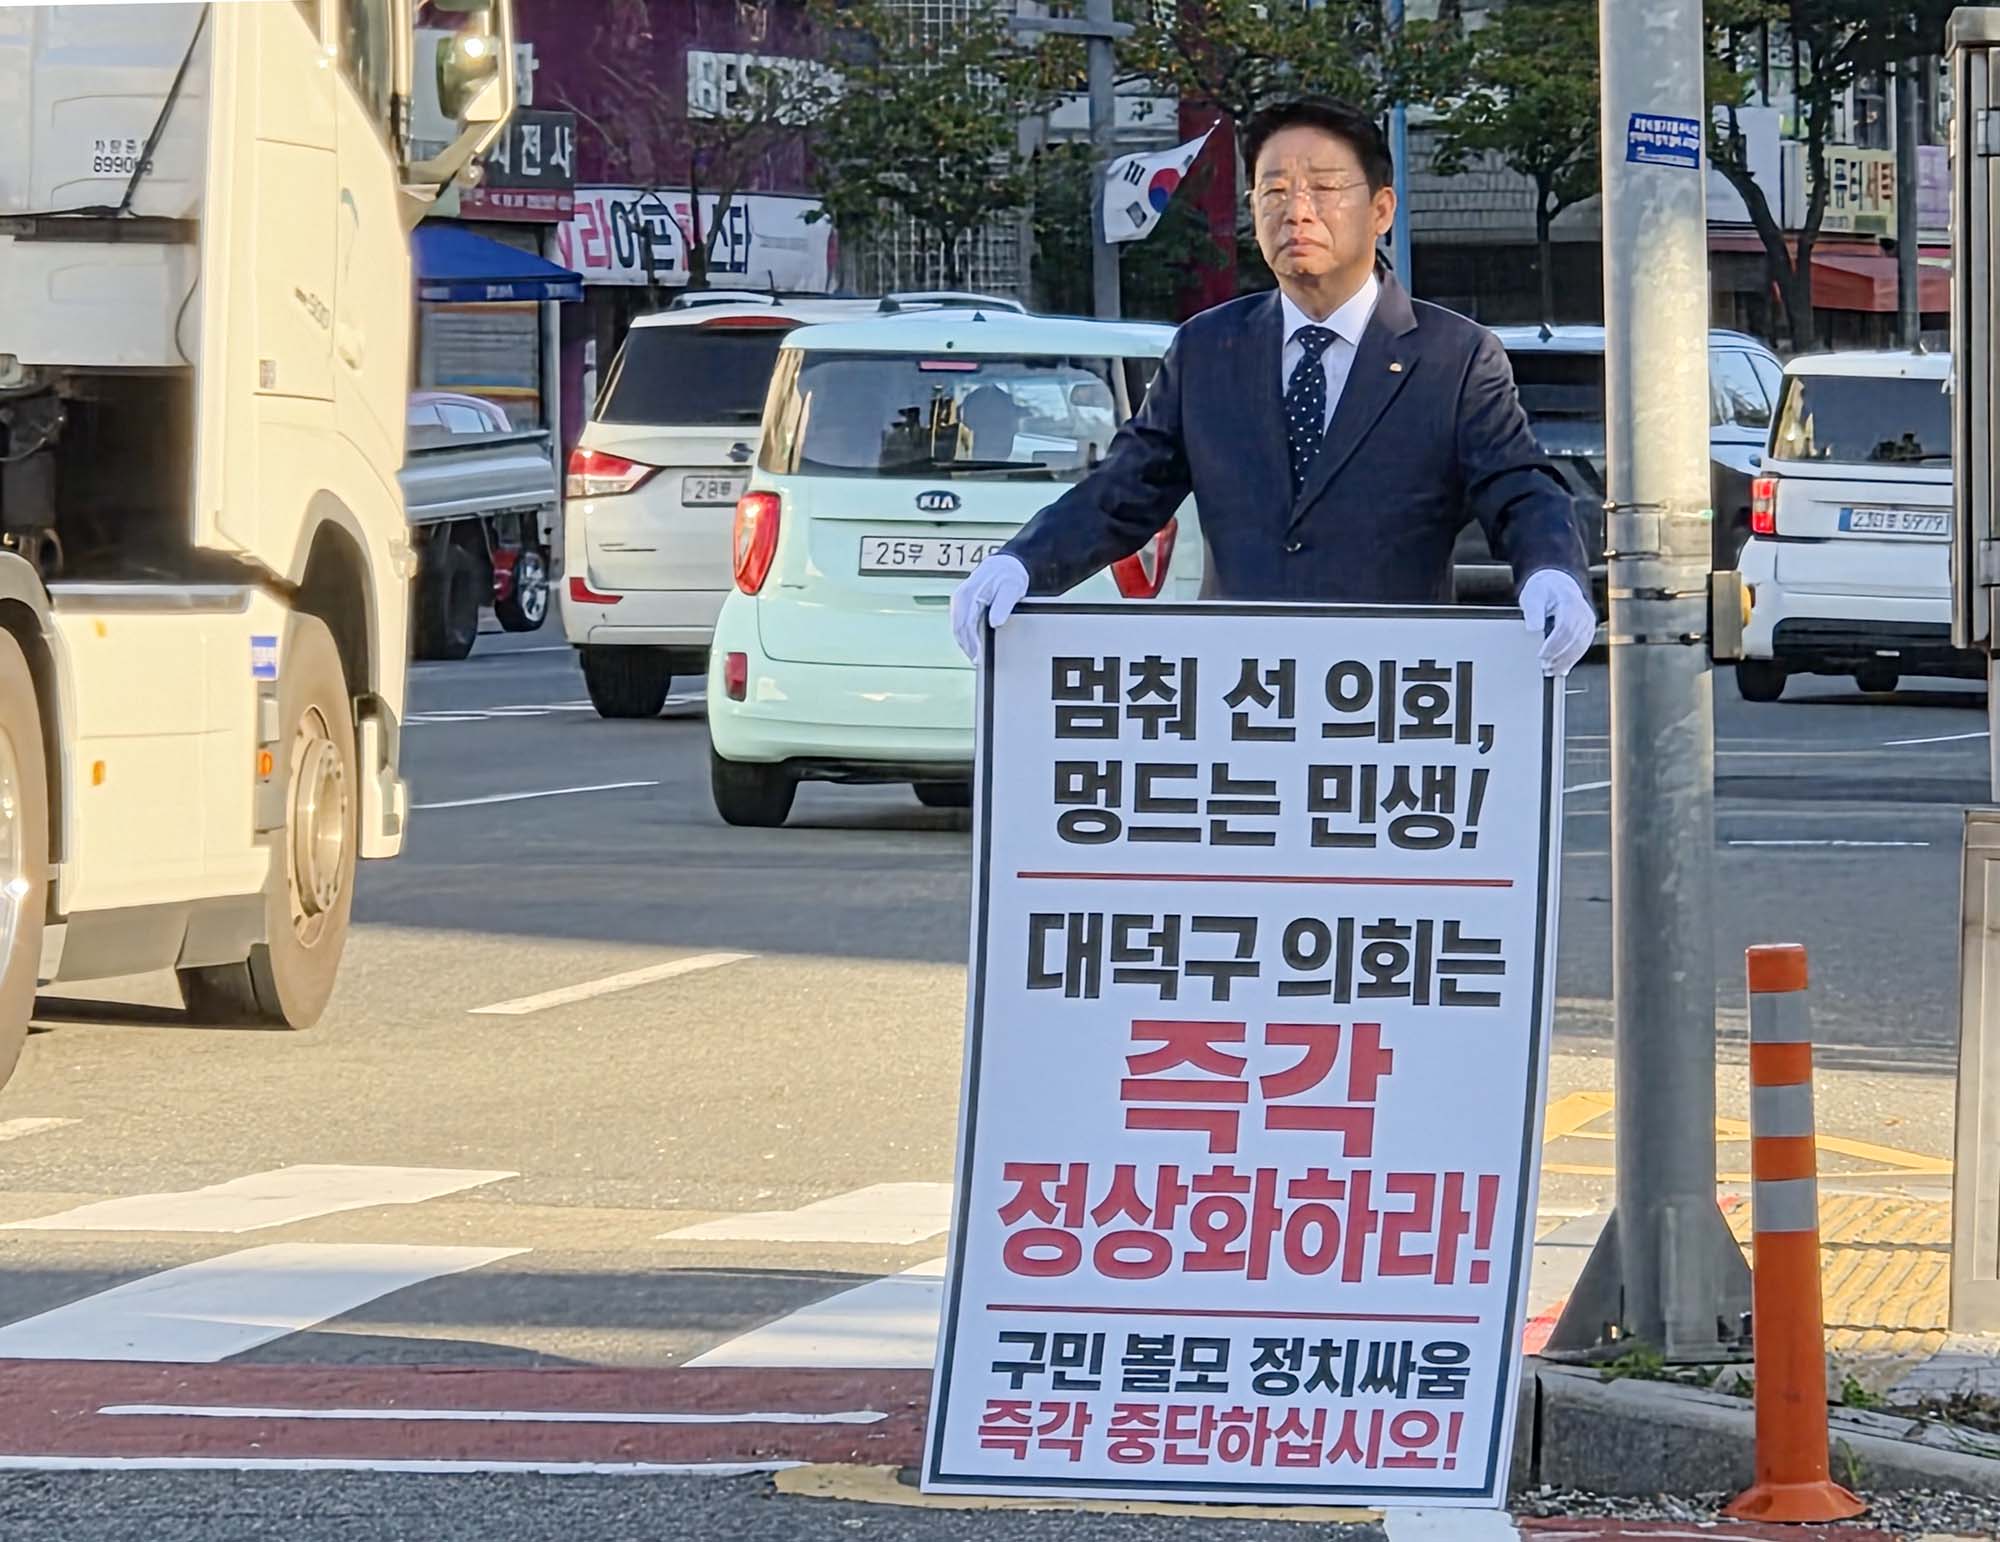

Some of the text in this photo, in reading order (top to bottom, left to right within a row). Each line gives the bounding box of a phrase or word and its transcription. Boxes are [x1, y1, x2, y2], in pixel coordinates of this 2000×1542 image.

[919, 495, 954, 509] KIA
[1051, 655, 1495, 754] 멈춰 선 의회,
[1053, 760, 1490, 850] 멍드는 민생!
[1027, 913, 1506, 1007] 대덕구 의회는
[1120, 1020, 1393, 1157] 즉각
[998, 1162, 1500, 1285] 정상화하라!
[991, 1331, 1471, 1399] 구민 볼모 정치싸움
[978, 1399, 1464, 1470] 즉각 중단하십시오!
